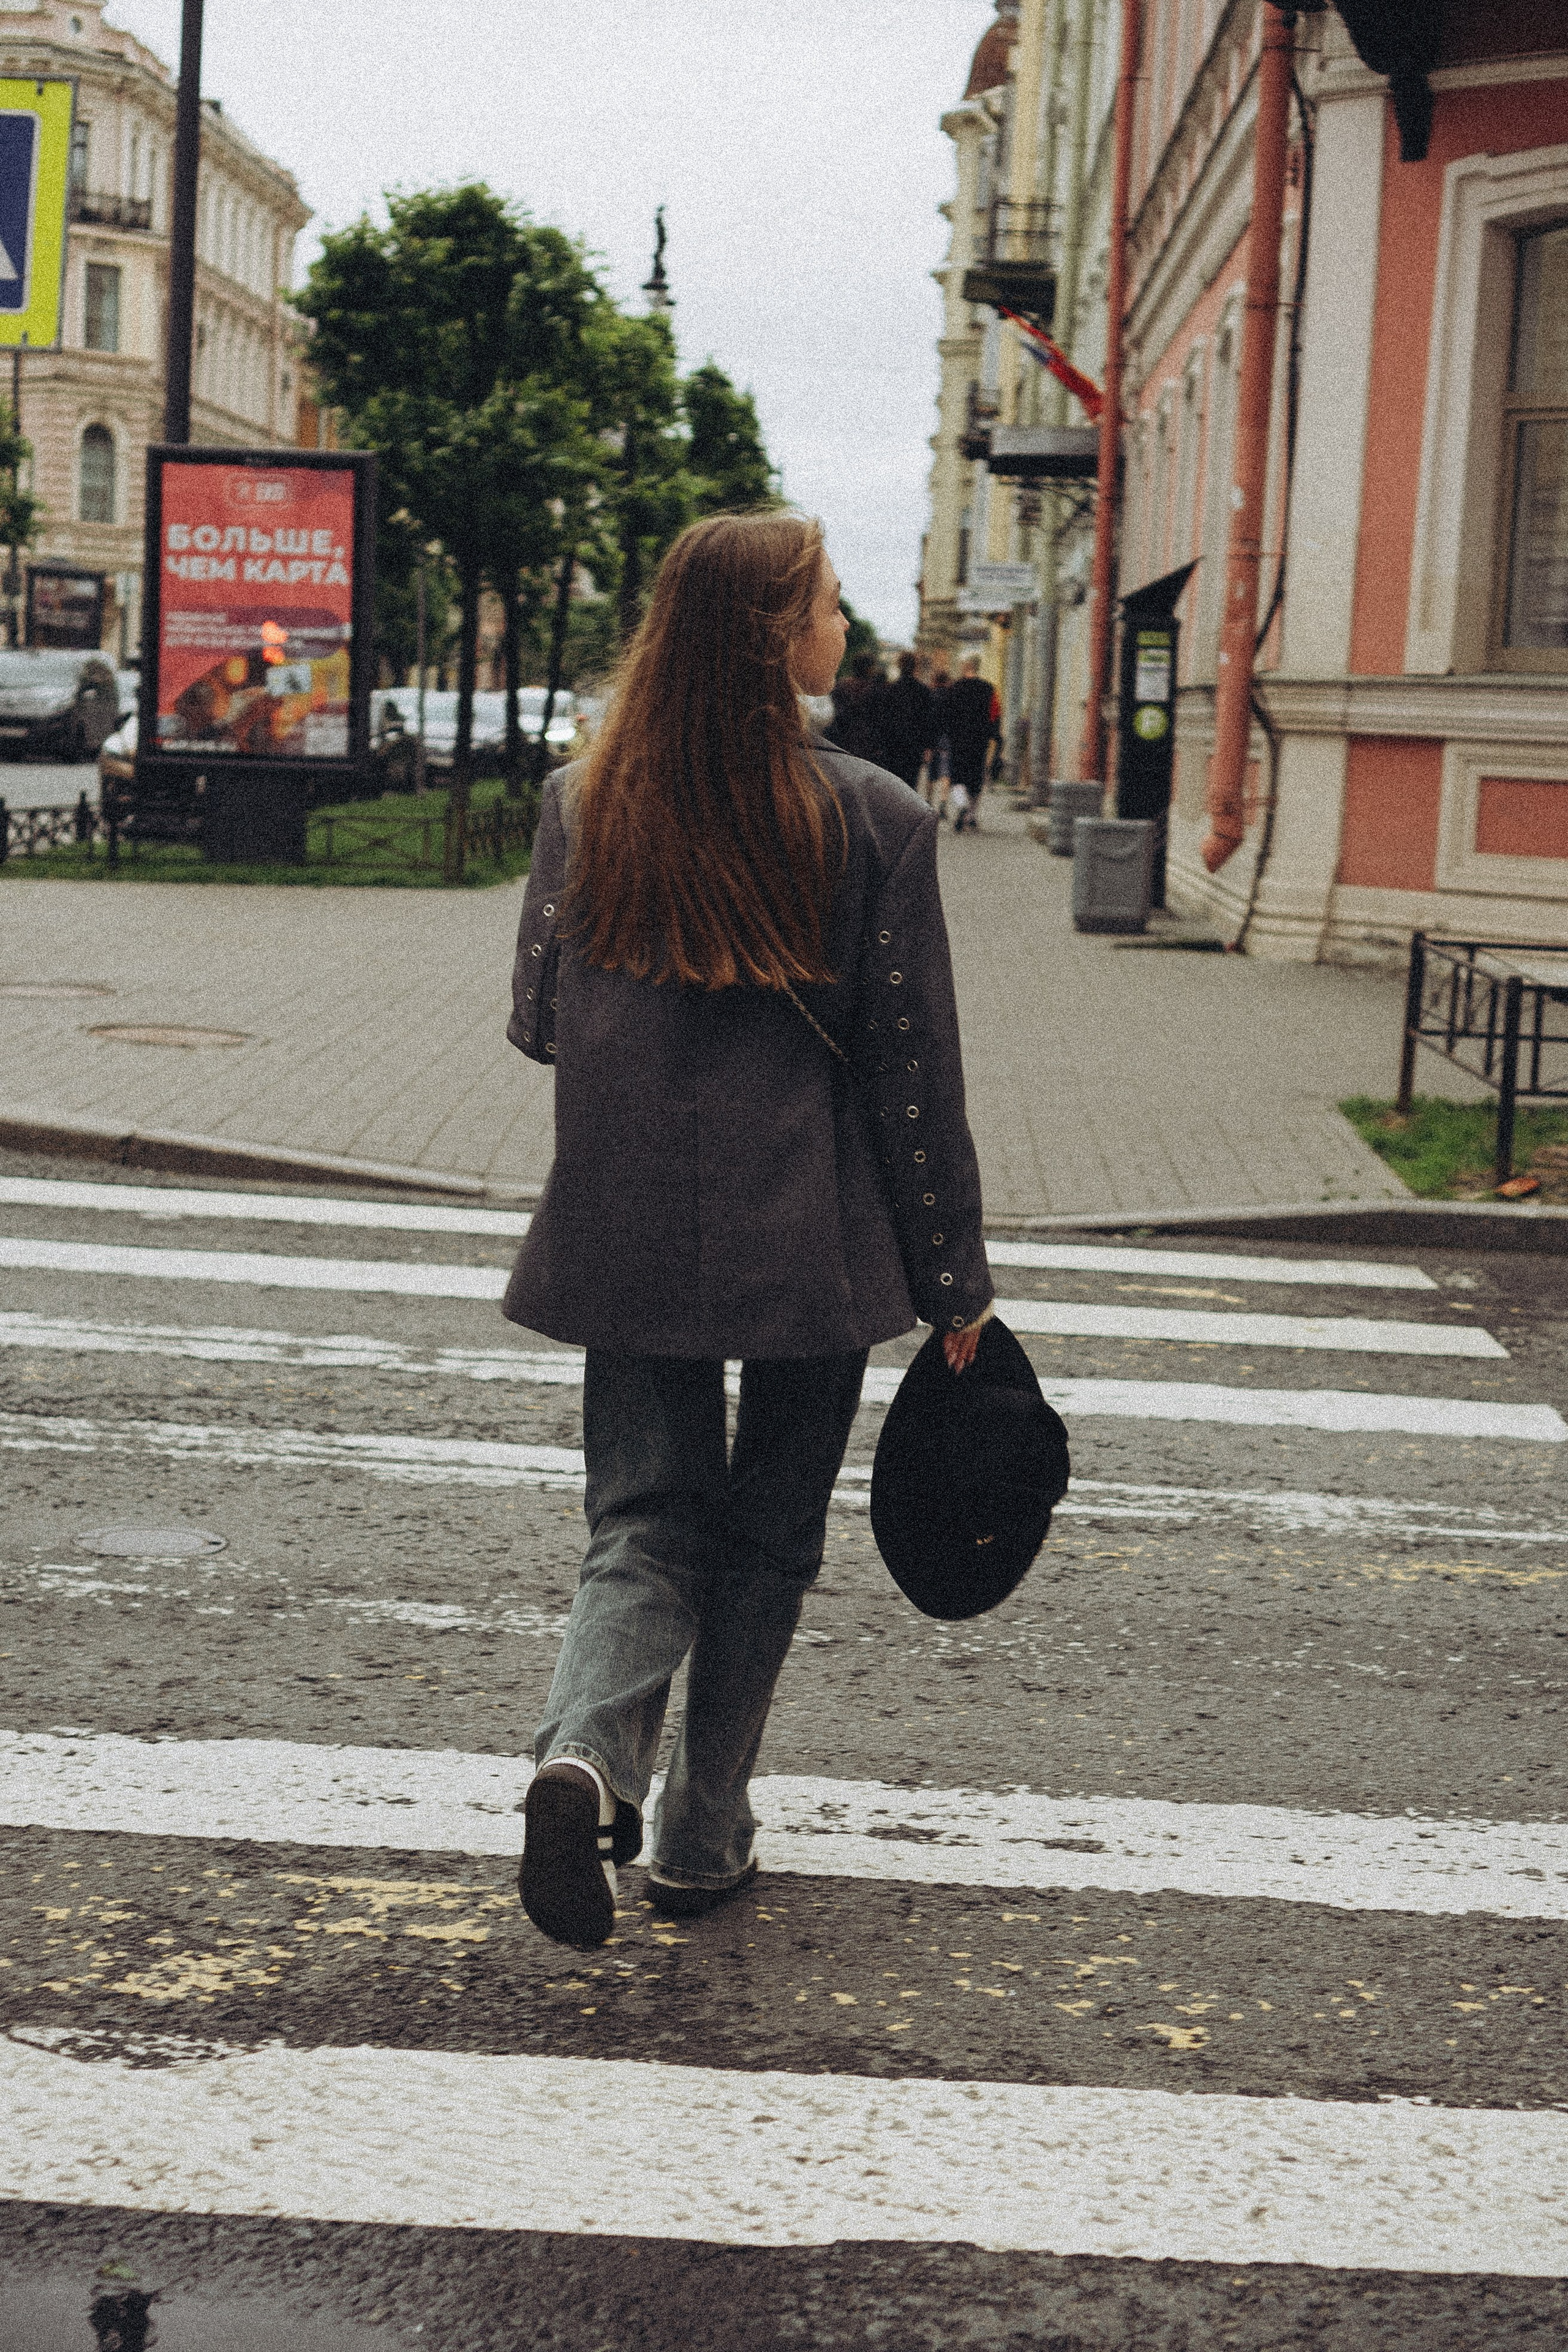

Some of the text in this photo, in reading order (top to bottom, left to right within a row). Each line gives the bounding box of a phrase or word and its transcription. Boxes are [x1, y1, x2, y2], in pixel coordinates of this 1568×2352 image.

[167, 524, 345, 559] БОЛЬШЕ,
[165, 555, 351, 585] ЧЕМ КАРТА
